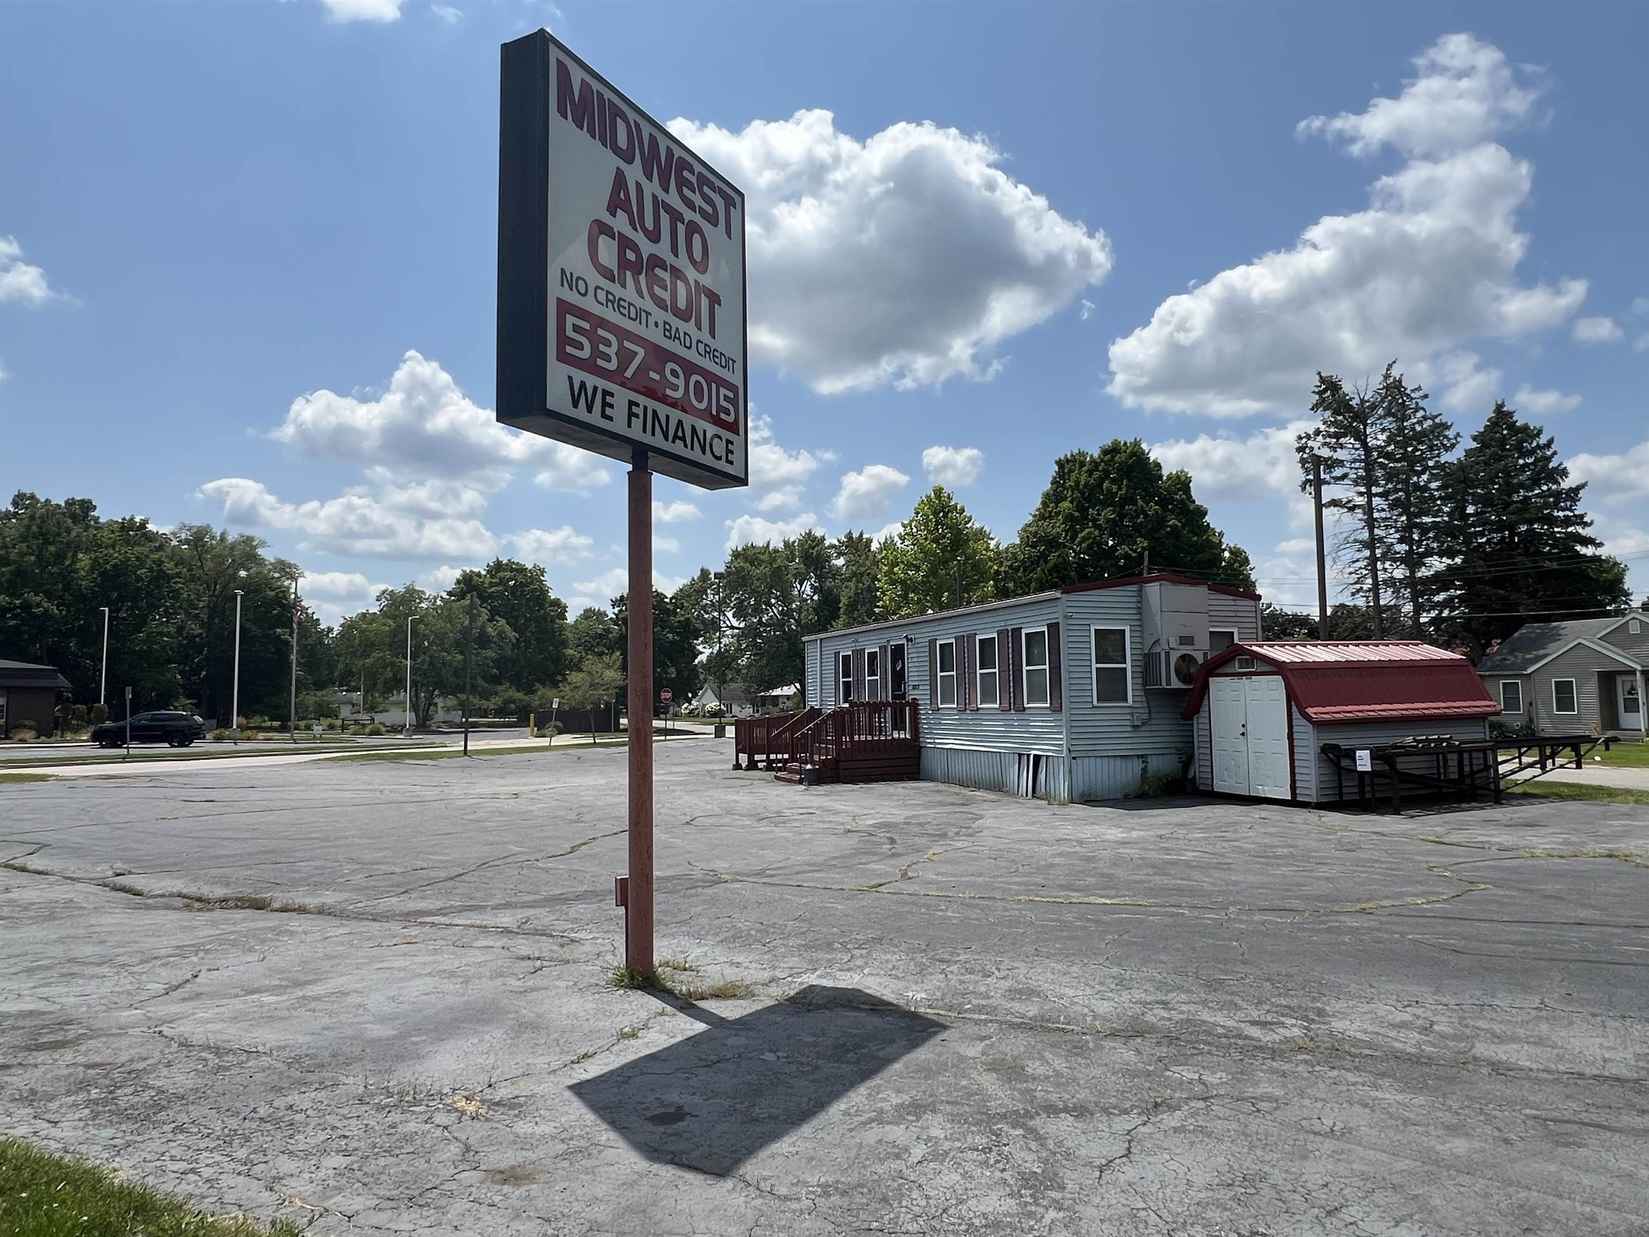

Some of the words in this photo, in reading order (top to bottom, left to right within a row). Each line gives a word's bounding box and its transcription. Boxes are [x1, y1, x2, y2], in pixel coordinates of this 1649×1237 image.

[556, 57, 736, 240] MIDWEST
[607, 167, 710, 275] AUTO
[560, 267, 588, 298] NO
[594, 286, 652, 330] CREDIT
[663, 321, 692, 351] BAD
[696, 340, 736, 374] CREDIT
[588, 219, 722, 339] CREDIT
[565, 310, 736, 423] 537-9015
[568, 374, 614, 423] WE
[627, 400, 735, 466] FINANCE
